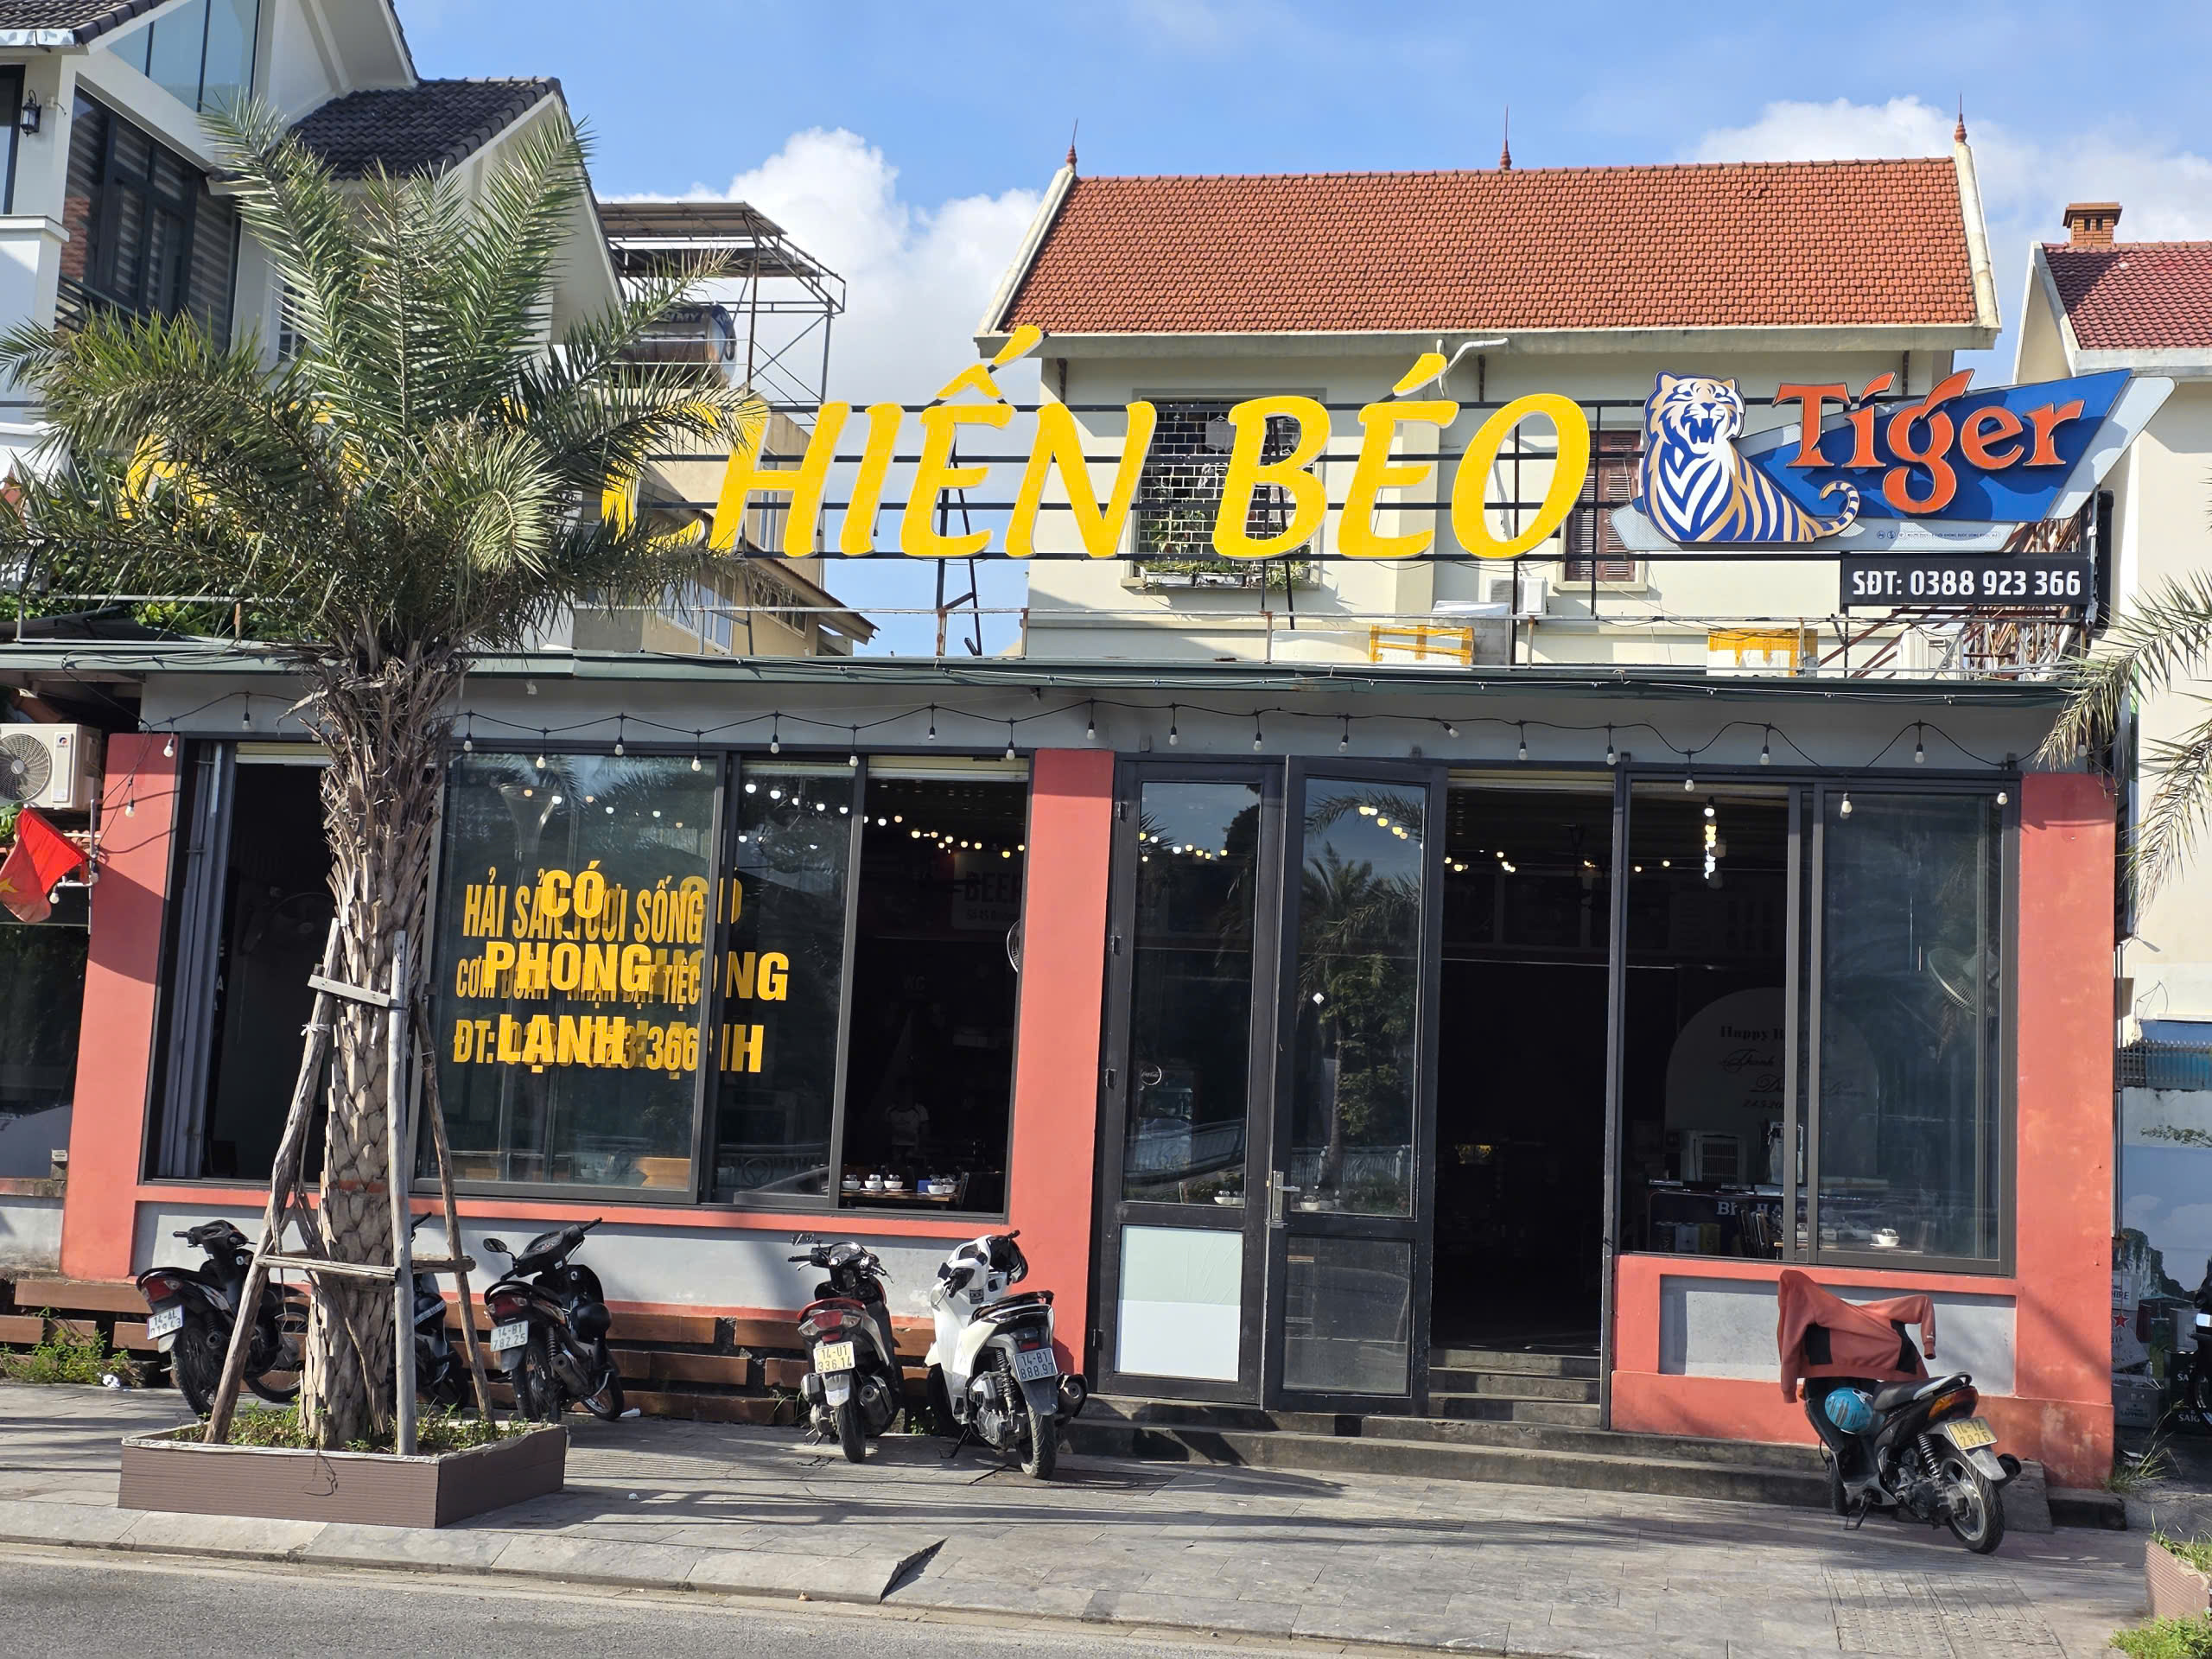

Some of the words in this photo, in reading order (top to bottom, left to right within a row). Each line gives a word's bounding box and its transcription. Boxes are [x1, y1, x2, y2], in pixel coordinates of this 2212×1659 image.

[1211, 353, 1591, 561] BÉO
[1772, 368, 2087, 515] Tiger
[1852, 569, 1903, 596] SĐT:
[1910, 569, 1975, 596] 0388
[1982, 569, 2027, 596] 923
[2033, 569, 2082, 596] 366
[462, 866, 508, 938] HẢI
[633, 874, 704, 944] SỐNG
[540, 860, 606, 919] CÓ
[483, 931, 652, 993] PHÒNG
[452, 1018, 496, 1065] ĐT:
[645, 1026, 700, 1071] 366
[496, 1013, 626, 1074] LẠNH
[493, 1332, 526, 1350] 782.25
[818, 1356, 853, 1372] 336.14
[821, 1344, 849, 1360] 14-U1
[1020, 1362, 1054, 1380] 888.97
[1960, 1431, 1992, 1448] 2826
